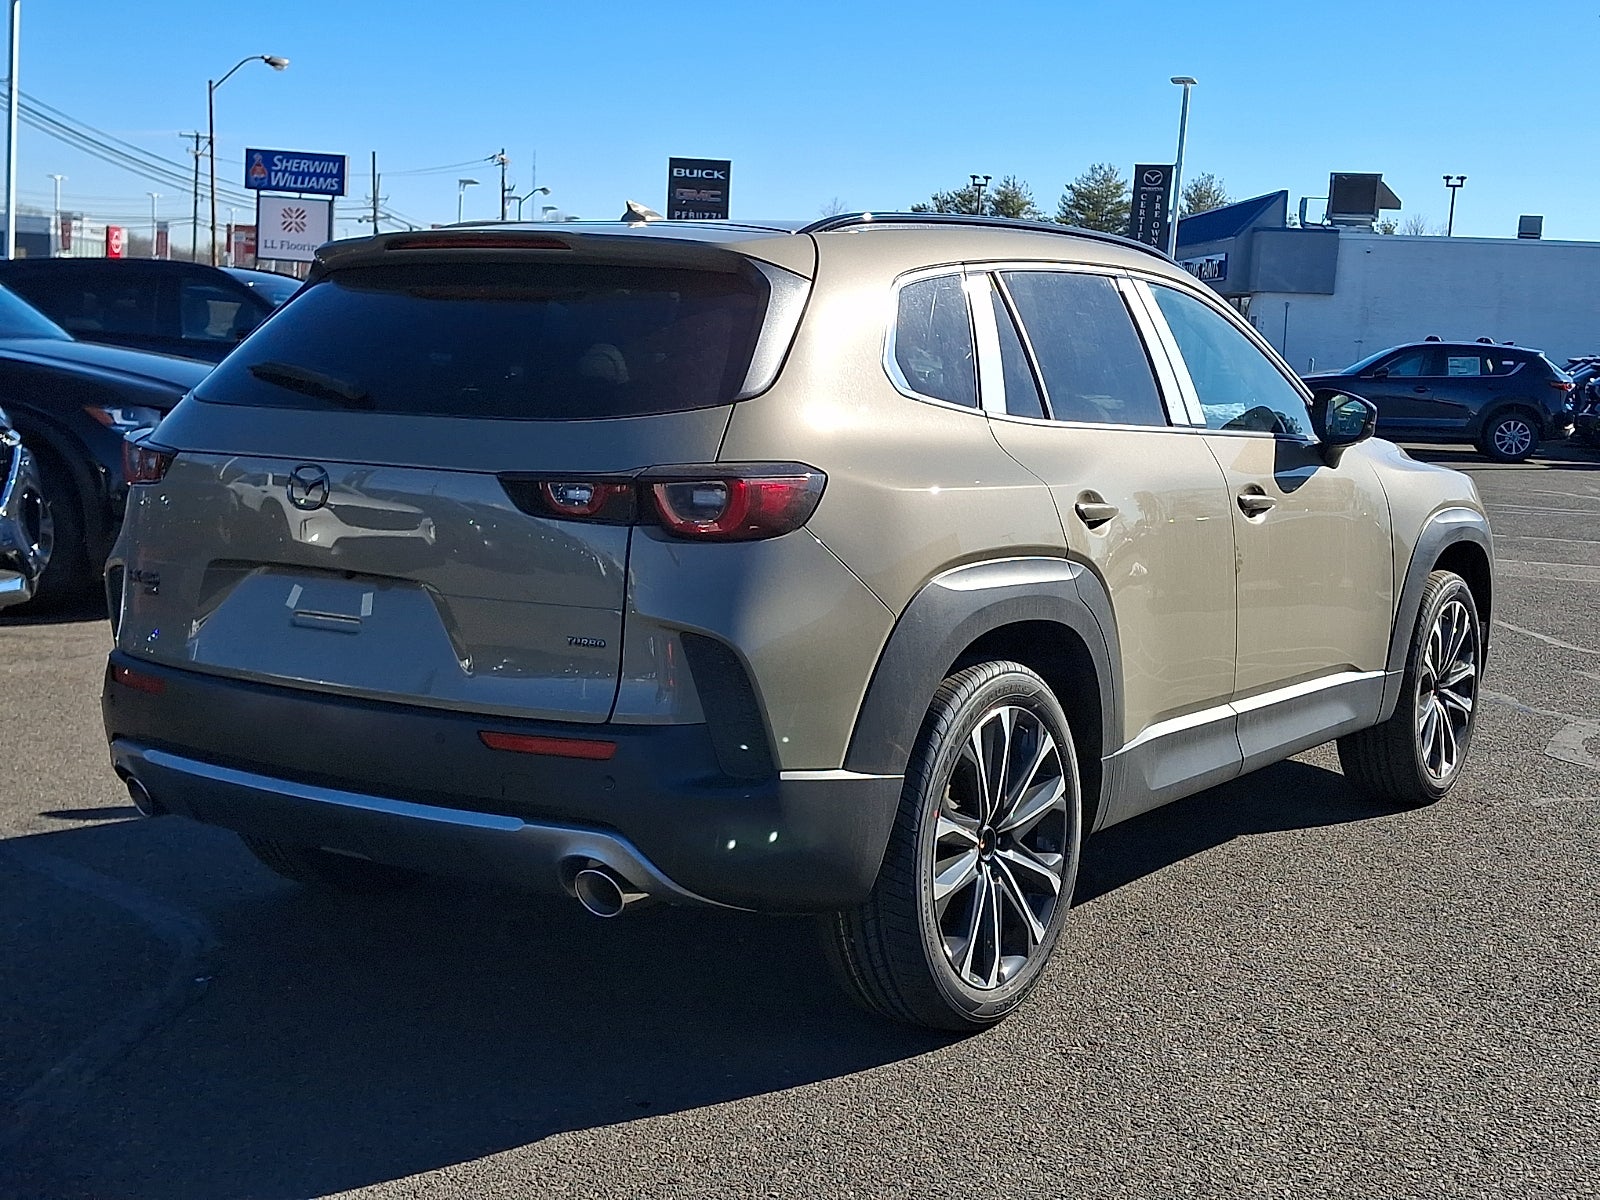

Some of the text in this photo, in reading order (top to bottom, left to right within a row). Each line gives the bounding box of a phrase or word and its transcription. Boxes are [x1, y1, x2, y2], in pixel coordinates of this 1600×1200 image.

[272, 155, 339, 175] SHERWIN
[673, 168, 726, 180] BUICK
[270, 172, 340, 191] WILLIAMS
[263, 239, 278, 249] LL
[566, 635, 607, 648] TURBO
